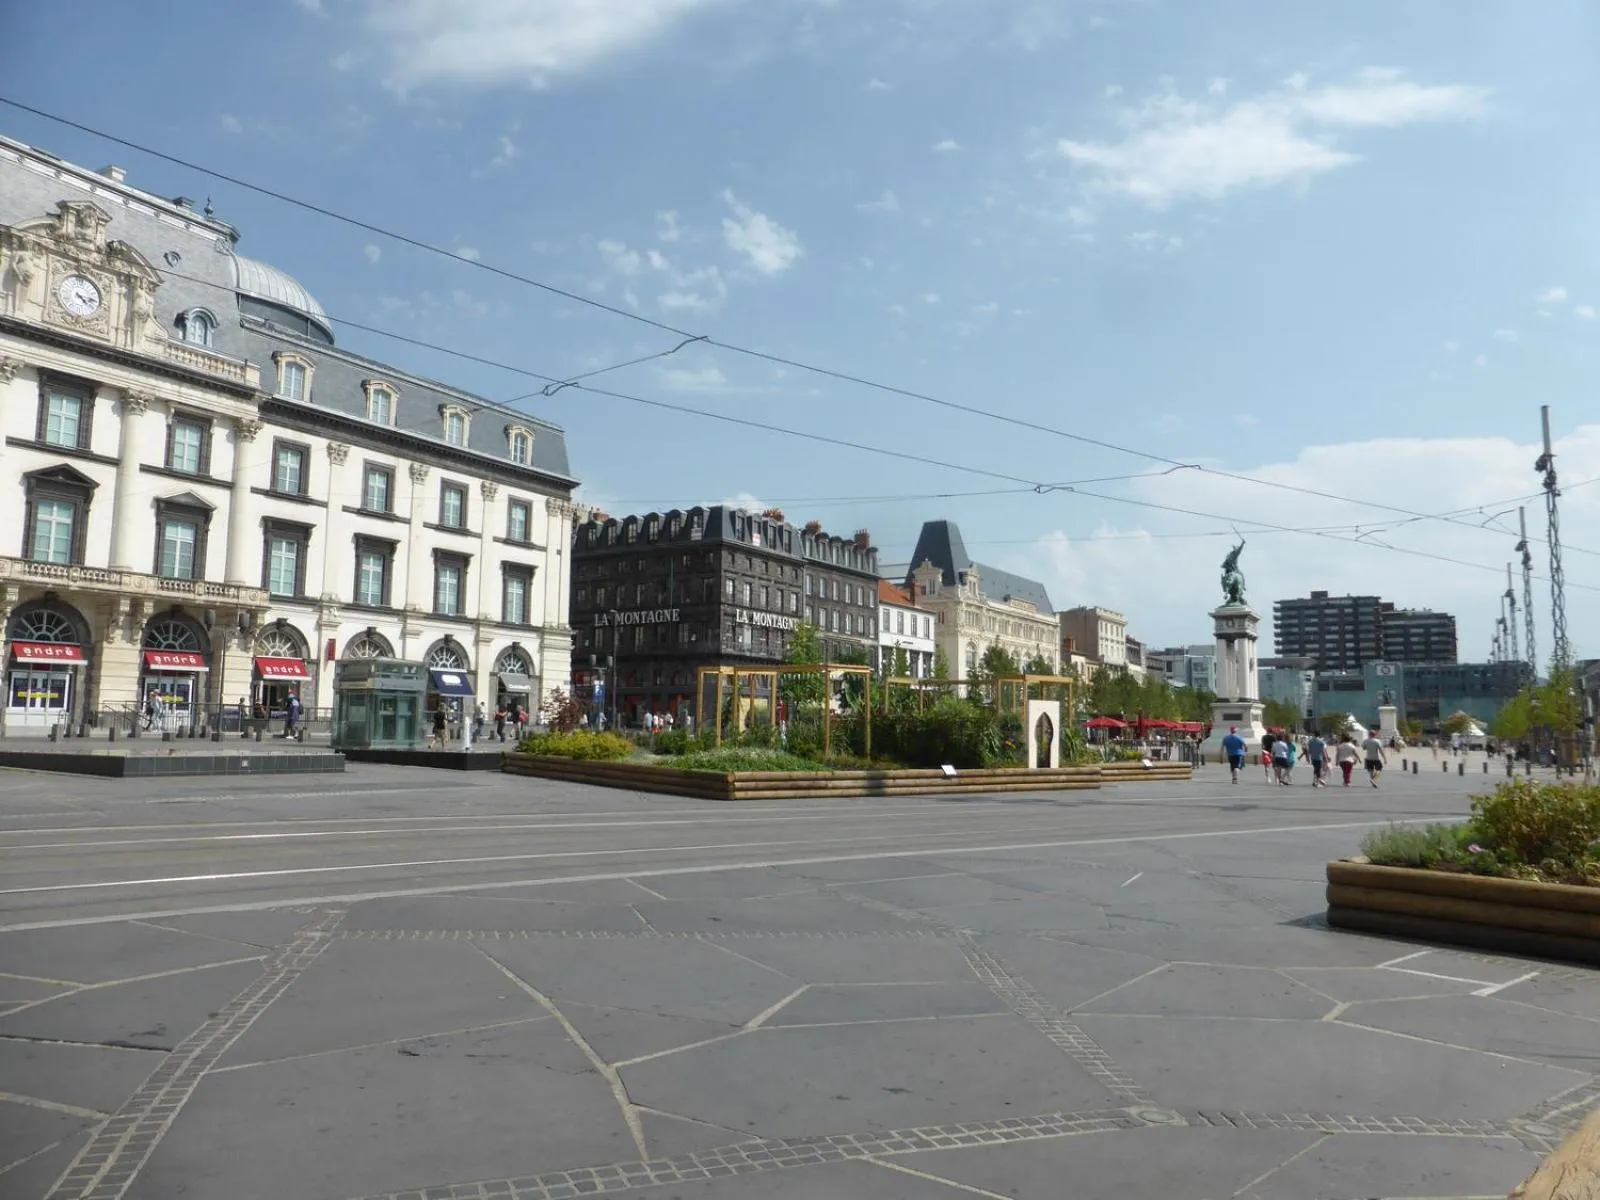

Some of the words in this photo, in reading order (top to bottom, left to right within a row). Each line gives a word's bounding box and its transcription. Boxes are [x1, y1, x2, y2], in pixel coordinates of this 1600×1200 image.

[594, 612, 609, 627] LA
[614, 608, 680, 625] MONTAGNE
[736, 608, 749, 623] LA
